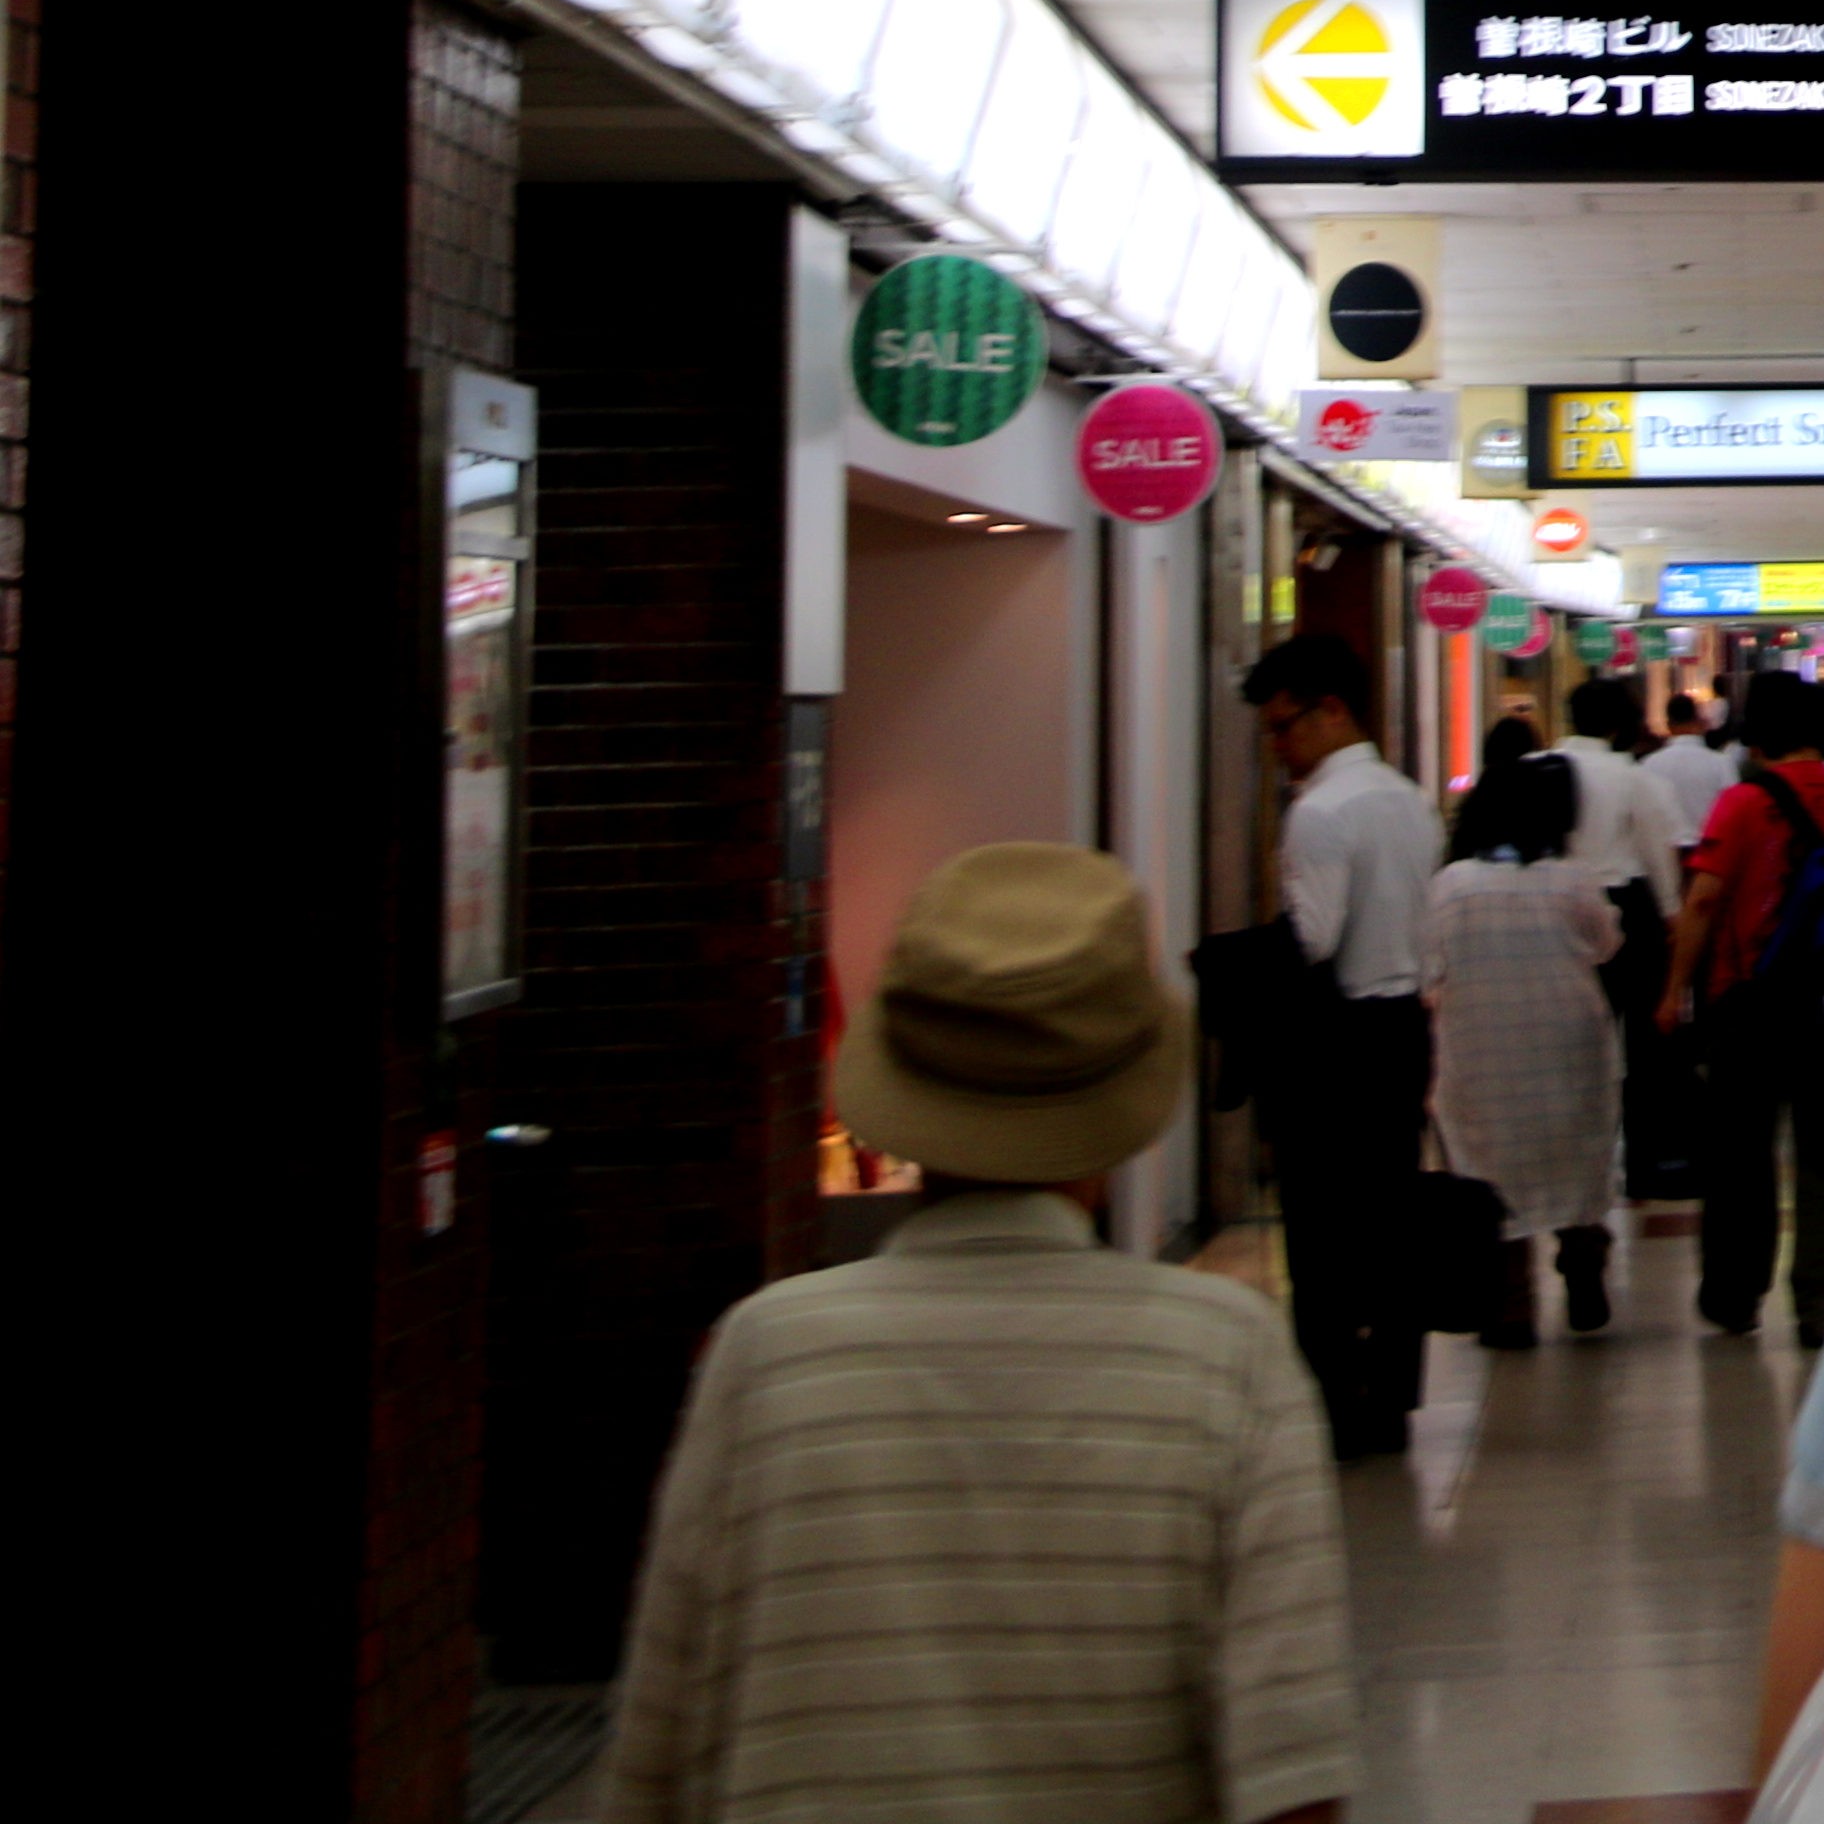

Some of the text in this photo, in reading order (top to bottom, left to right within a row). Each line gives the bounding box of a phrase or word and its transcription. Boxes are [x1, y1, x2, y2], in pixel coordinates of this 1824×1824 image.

[871, 328, 1016, 374] SALE
[1637, 411, 1784, 449] Perfect
[1091, 436, 1202, 471] SALE
[1427, 590, 1481, 607] SALE
